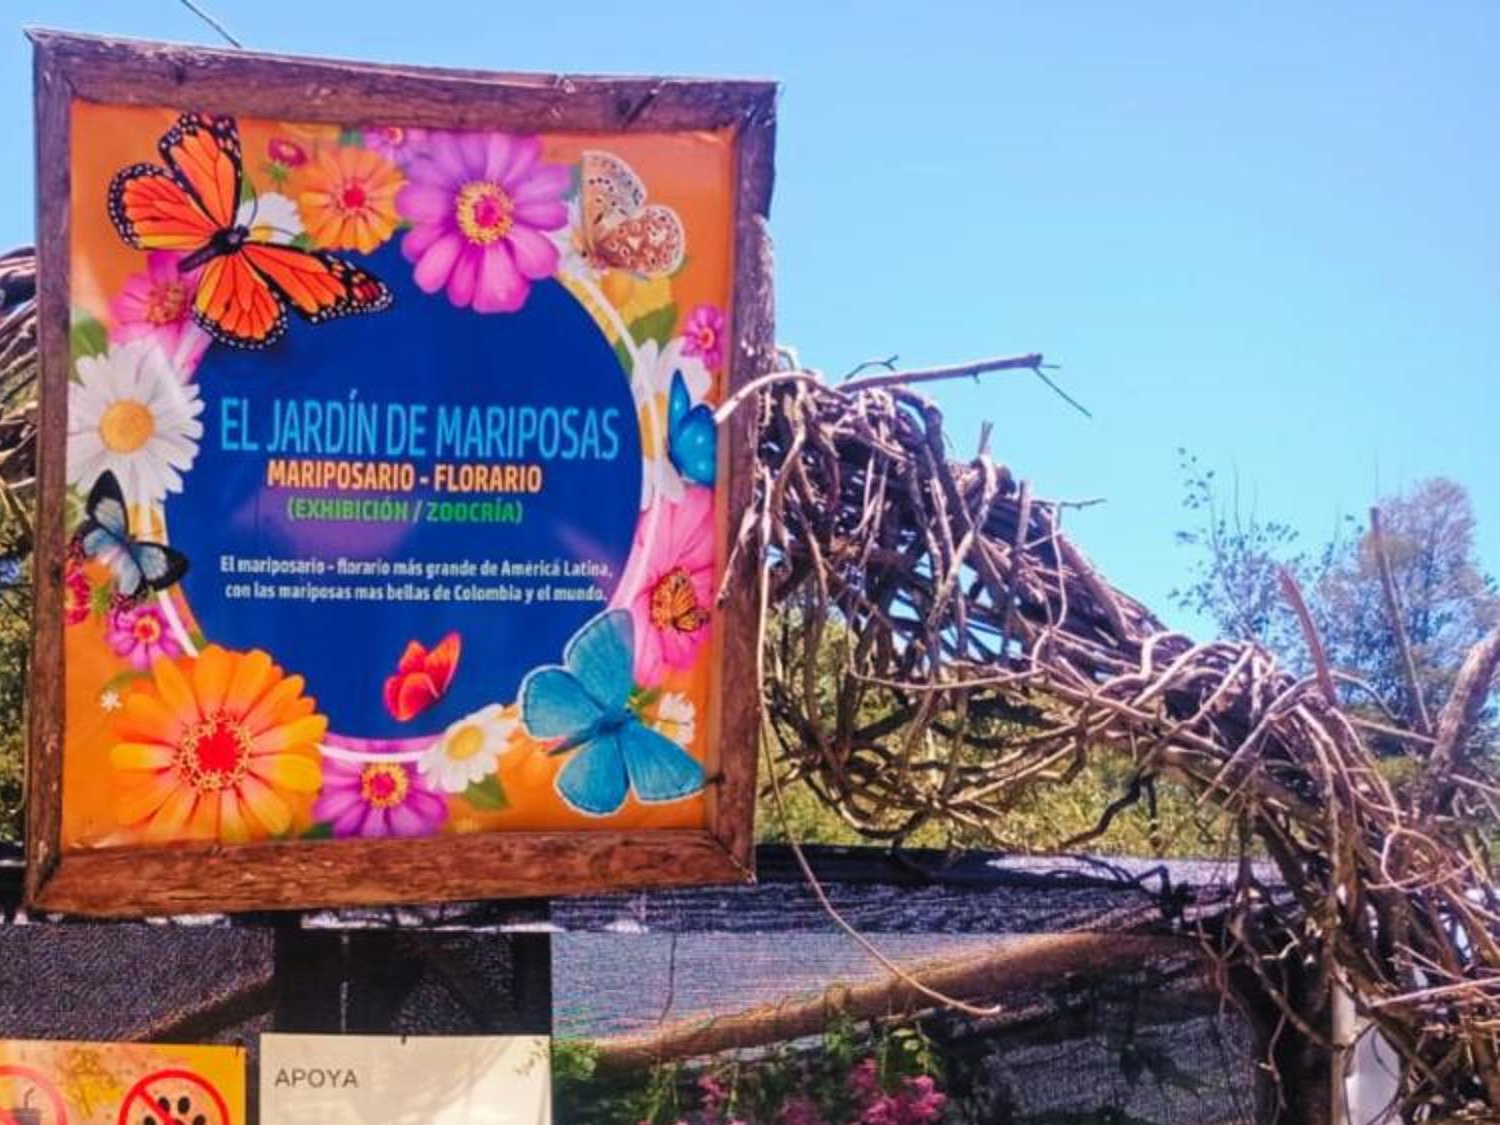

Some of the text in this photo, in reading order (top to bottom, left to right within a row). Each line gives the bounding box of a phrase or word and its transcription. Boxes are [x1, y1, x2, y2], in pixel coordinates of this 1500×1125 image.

[221, 389, 620, 461] EL JARDÍN DE MARIPOSAS
[267, 459, 415, 491] MARIPOSARIO
[434, 464, 543, 492] FLORARIO
[287, 496, 408, 521] (EXHIBICIÓN
[426, 498, 523, 524] ZOOCRÍA)
[220, 555, 235, 572] El
[237, 556, 325, 576] mariposario
[337, 557, 390, 575] florario
[393, 557, 422, 575] más
[425, 560, 477, 579] grande
[480, 560, 498, 576] de
[563, 560, 613, 579] Latina,
[225, 584, 250, 598] con
[253, 581, 276, 599] las
[279, 583, 352, 603] mariposas
[386, 583, 430, 601] bellas
[433, 584, 450, 601] de
[454, 584, 522, 602] Colombia
[524, 589, 534, 604] y
[536, 585, 550, 601] el
[274, 1067, 359, 1089] APOYA
